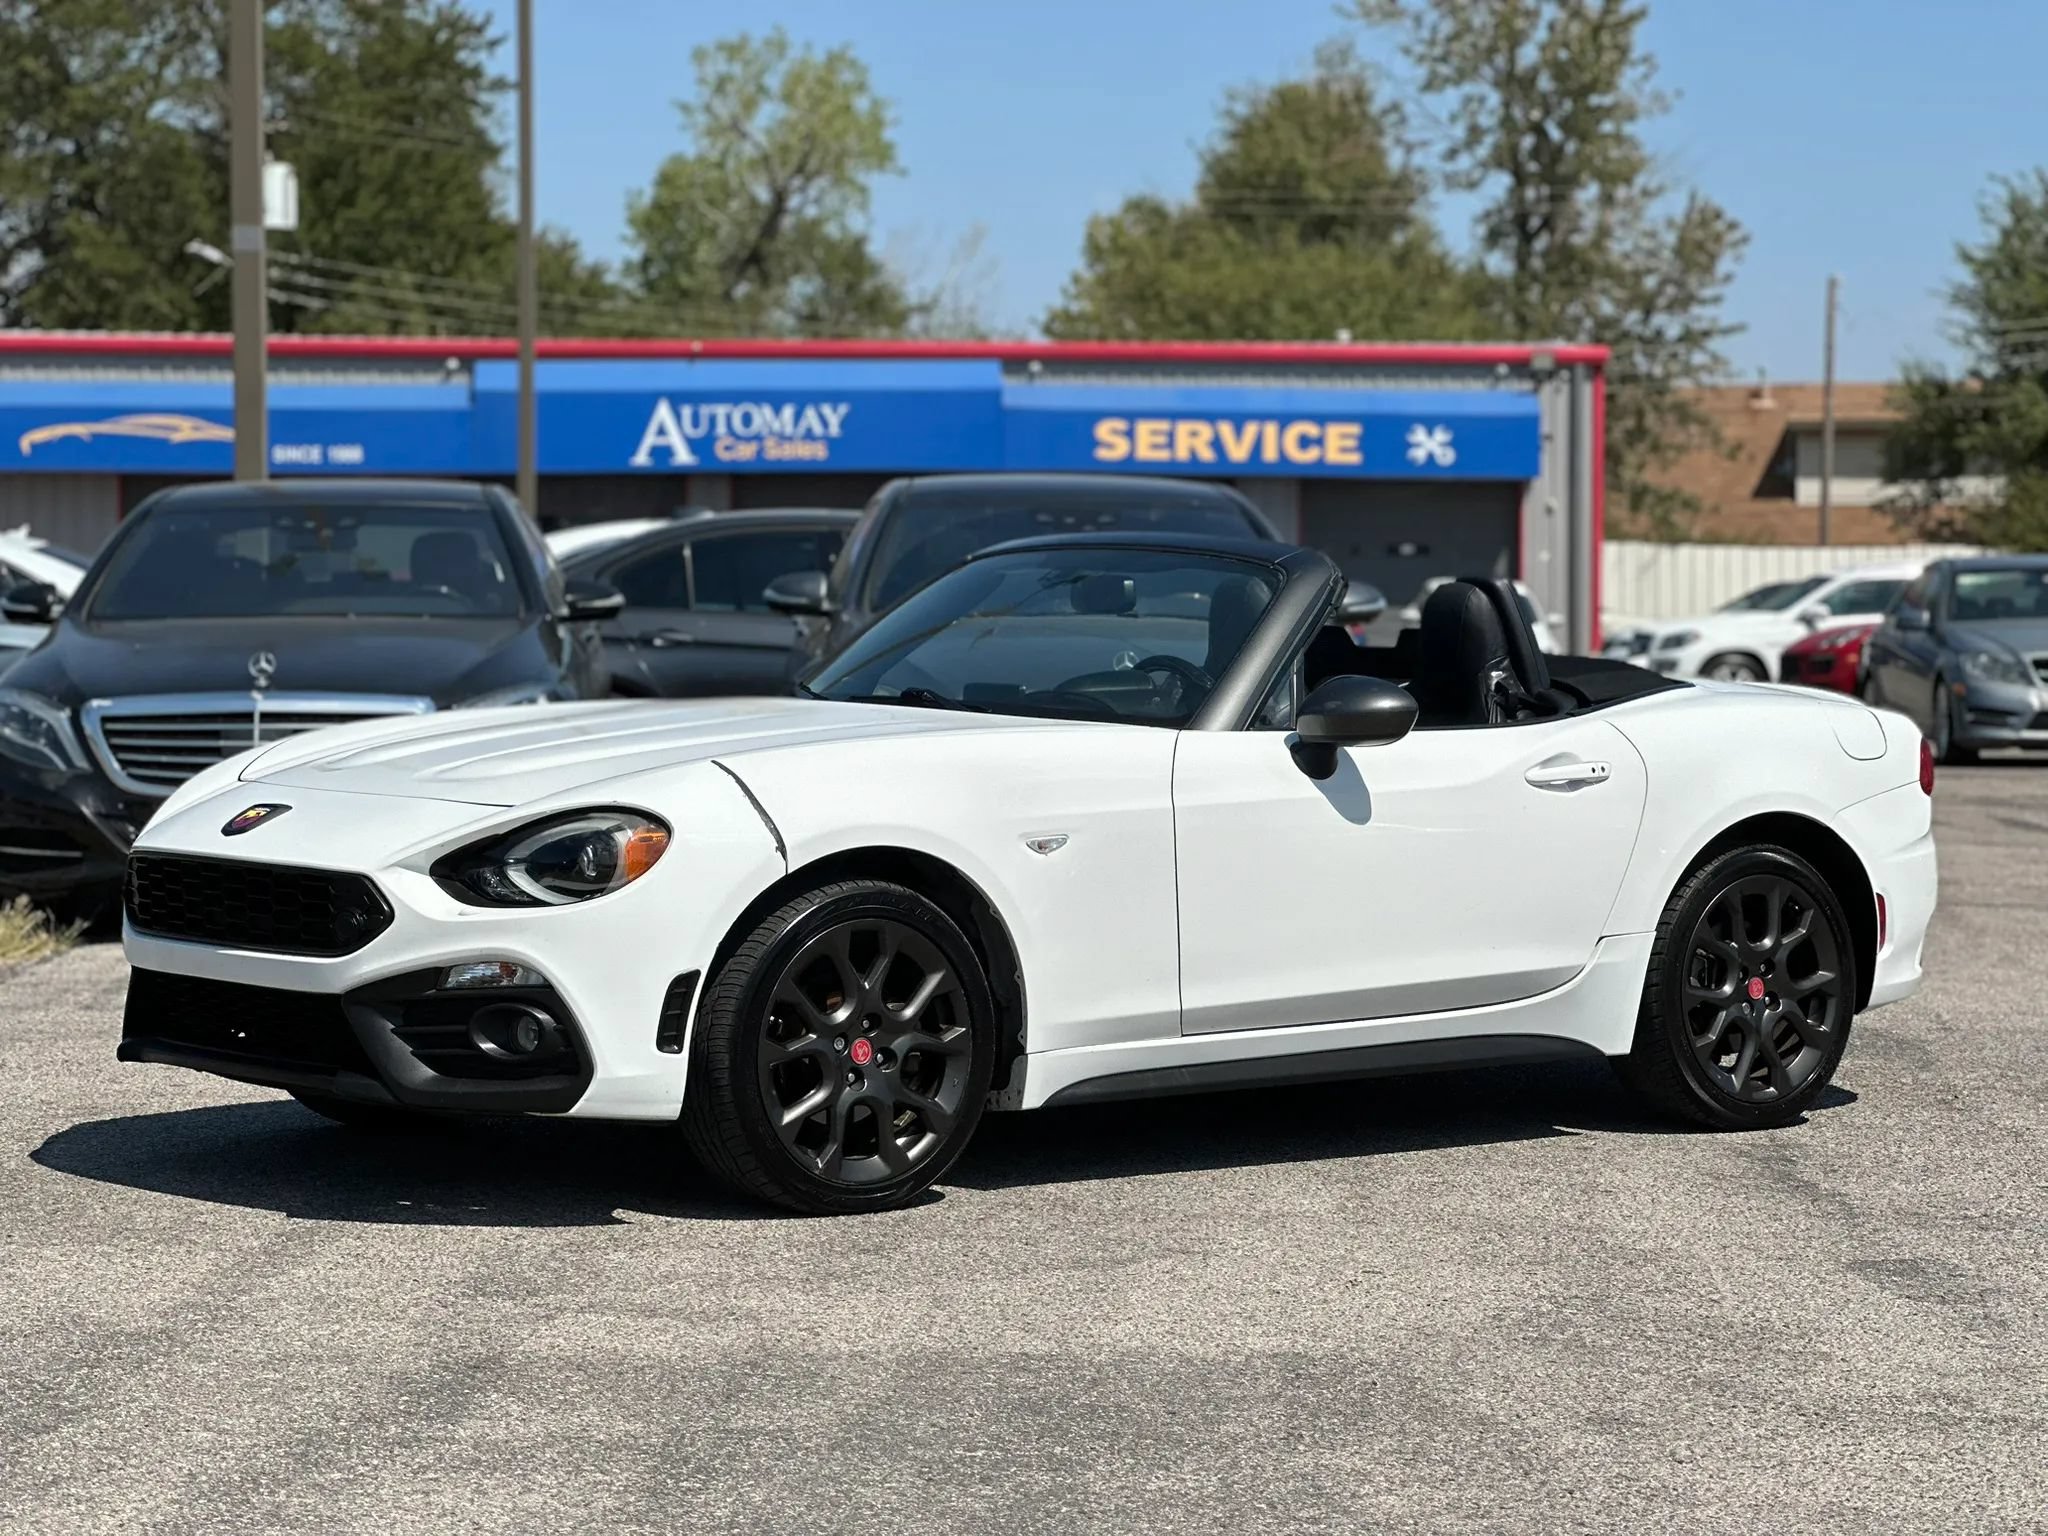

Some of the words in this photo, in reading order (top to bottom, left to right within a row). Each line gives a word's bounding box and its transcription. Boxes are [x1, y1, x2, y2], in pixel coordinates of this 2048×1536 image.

[629, 397, 849, 466] AUTOMAY
[714, 437, 757, 461] Car
[763, 436, 829, 461] Sales
[1093, 418, 1363, 466] SERVICE
[271, 443, 323, 464] SINCE
